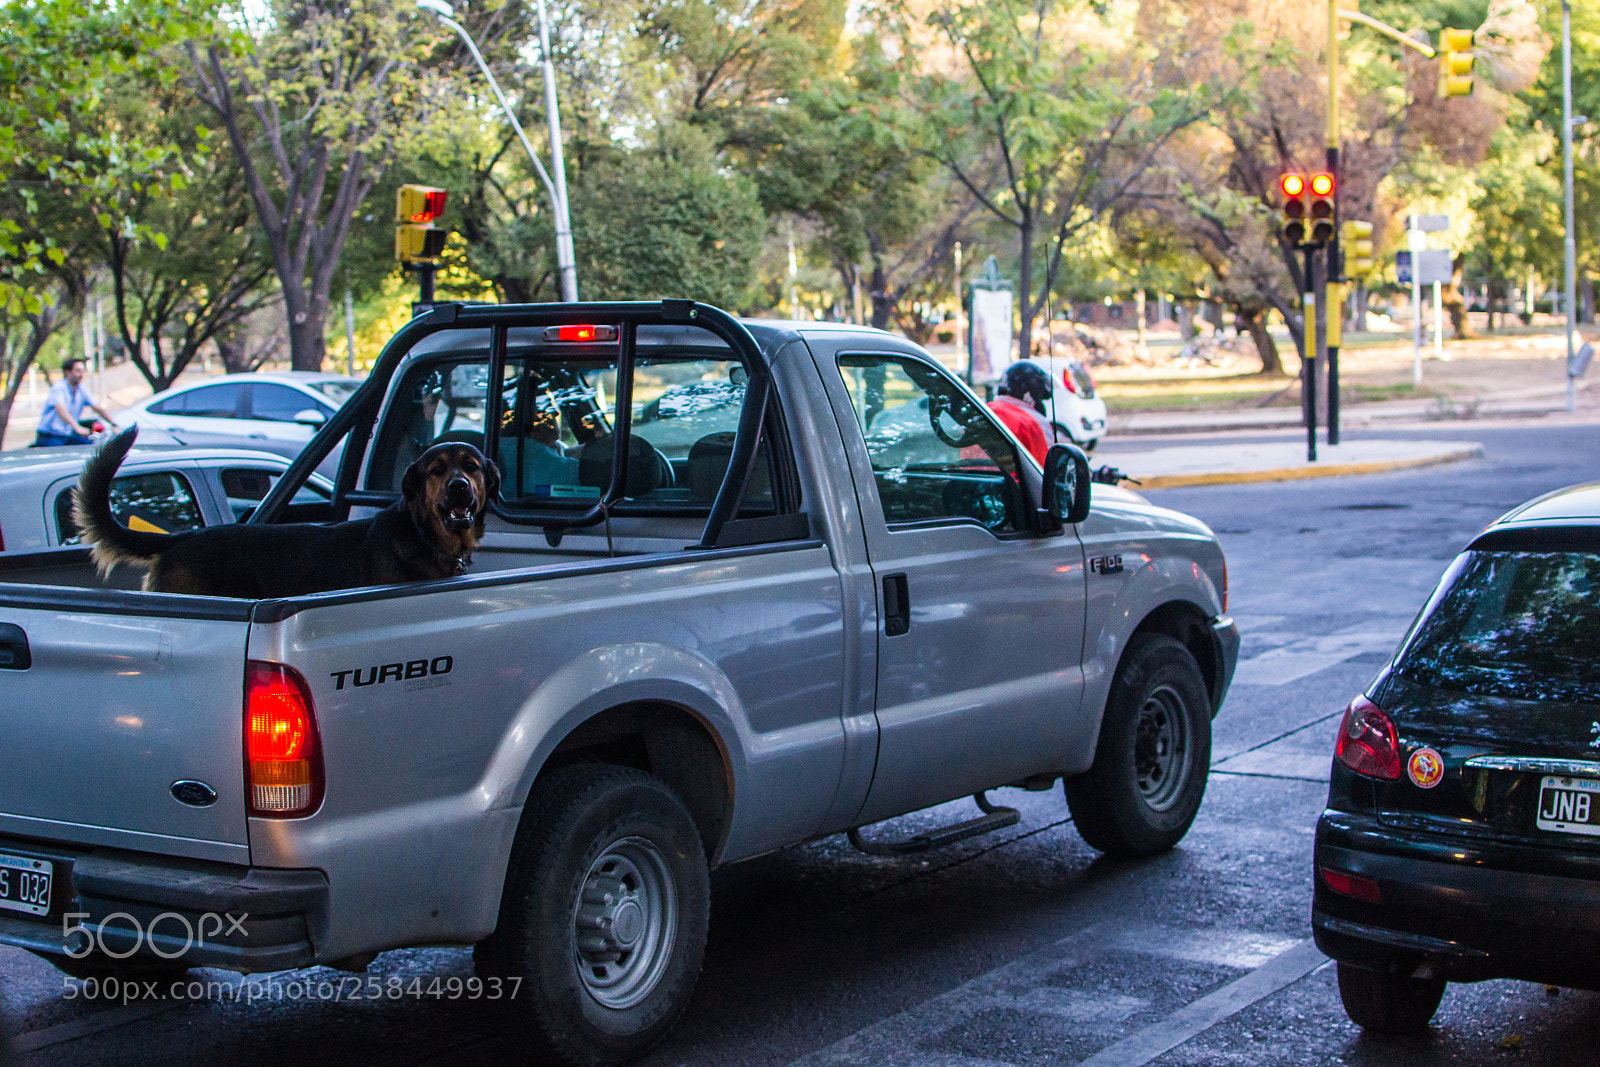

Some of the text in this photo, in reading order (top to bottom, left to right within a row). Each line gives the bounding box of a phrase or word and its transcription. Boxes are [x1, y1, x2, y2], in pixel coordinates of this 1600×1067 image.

[330, 656, 453, 691] TURBO
[1543, 790, 1591, 822] JNB
[0, 869, 48, 904] S 032
